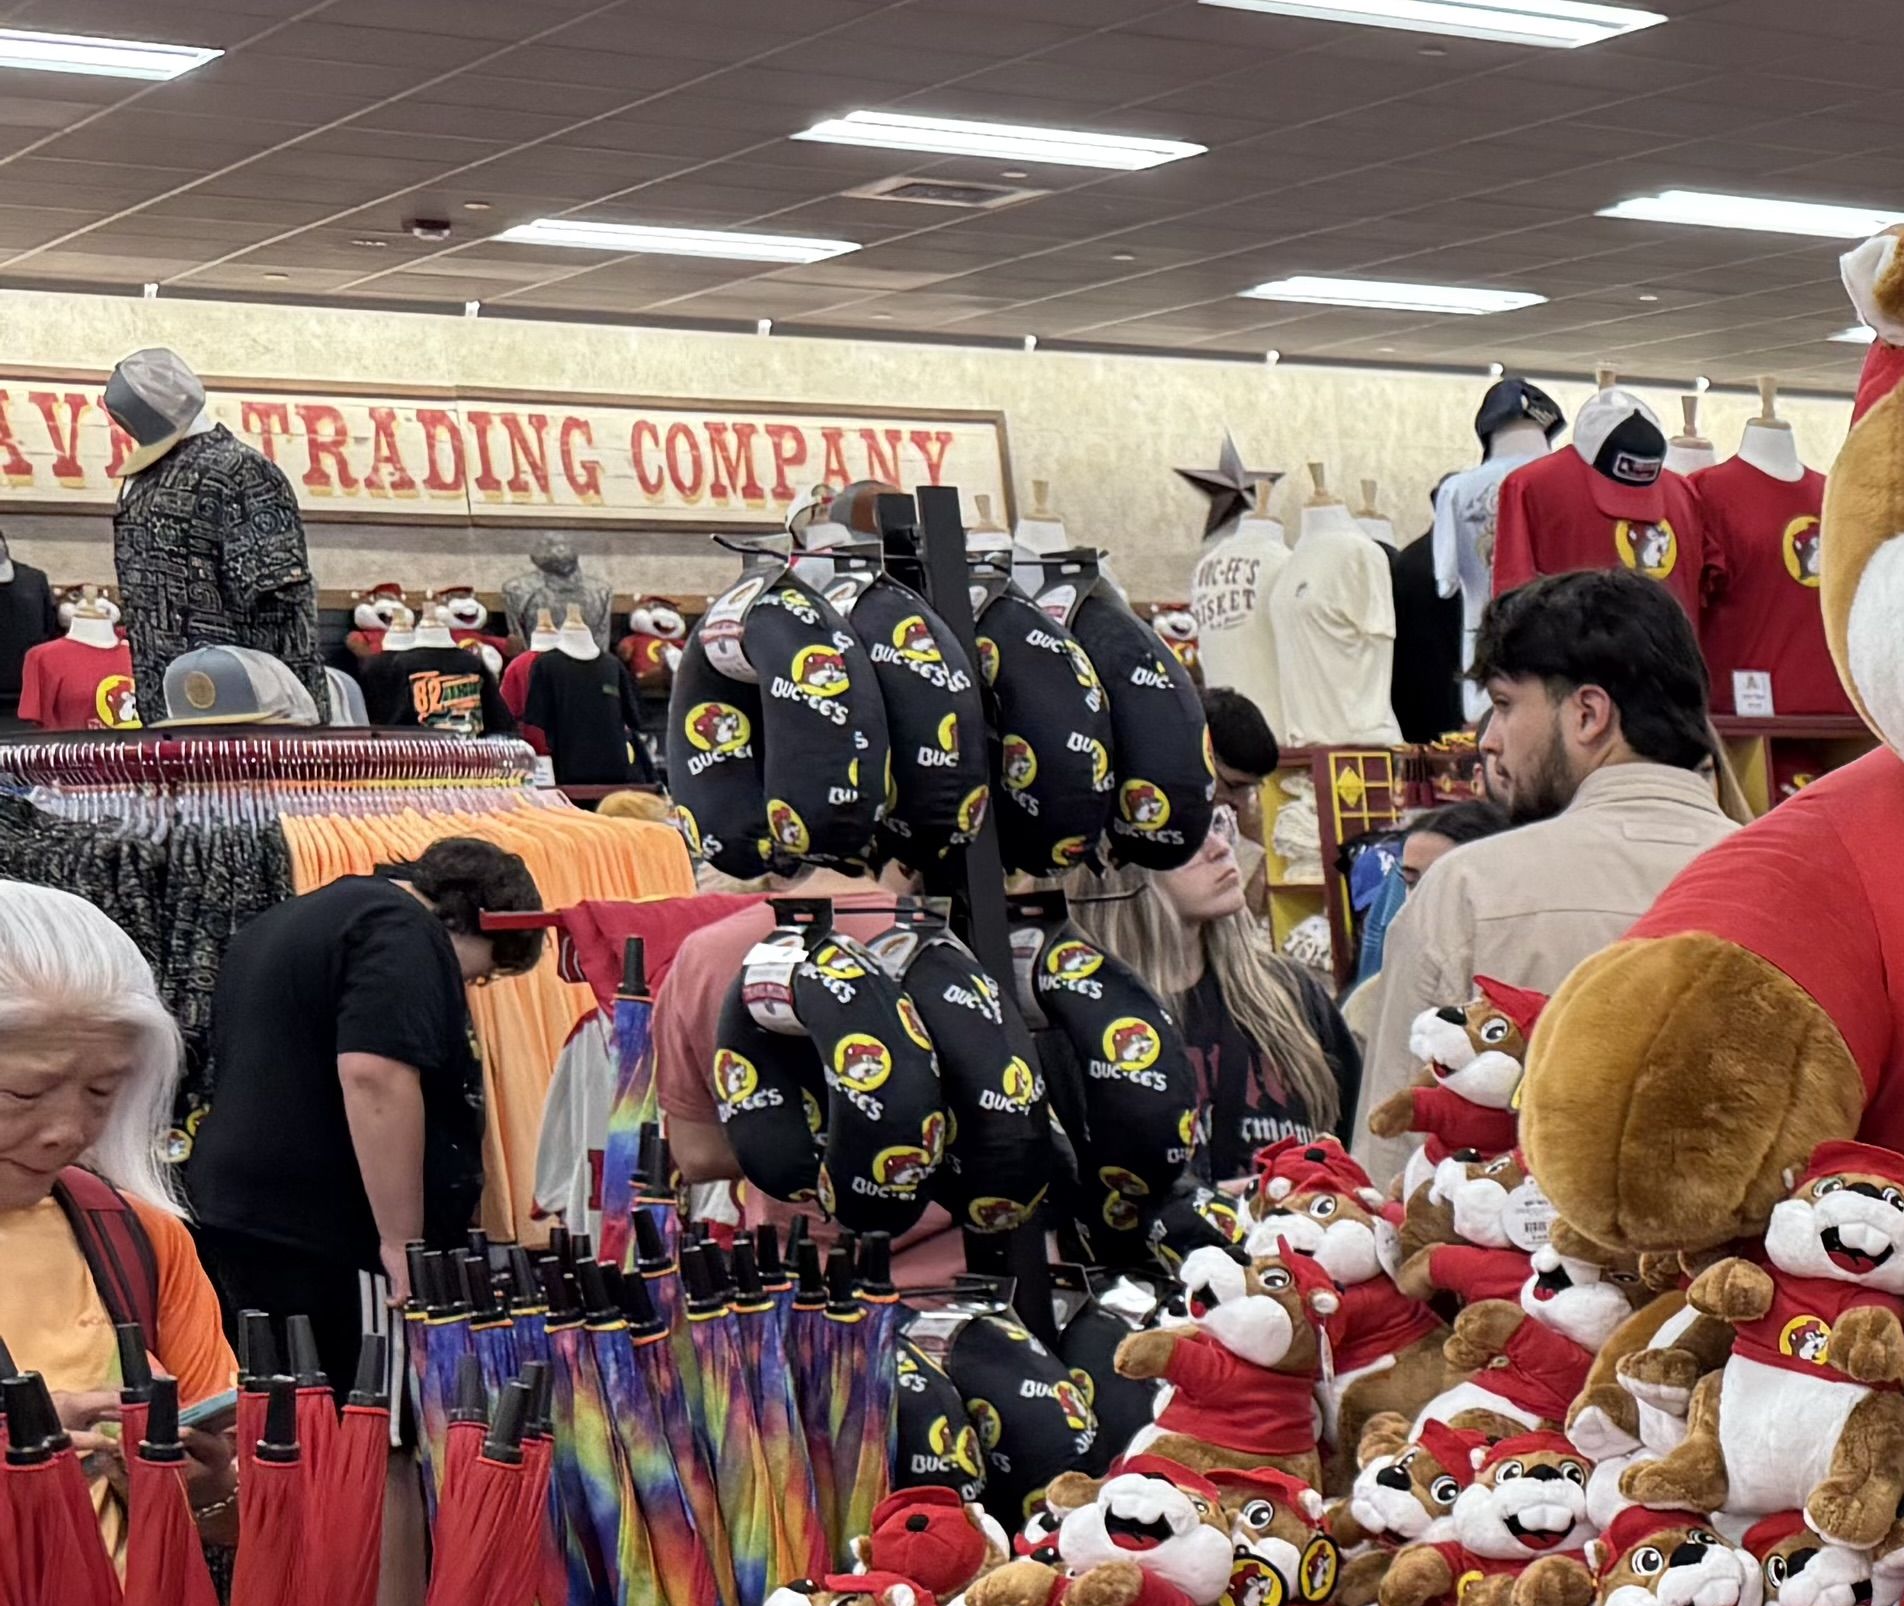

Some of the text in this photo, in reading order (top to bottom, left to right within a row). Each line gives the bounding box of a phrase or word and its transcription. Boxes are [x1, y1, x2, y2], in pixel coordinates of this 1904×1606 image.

[241, 401, 604, 499] TRADING
[630, 419, 954, 501] COMPANY
[770, 676, 850, 726] BUC-EE'S
[1089, 1060, 1168, 1092] BUC-EE'S
